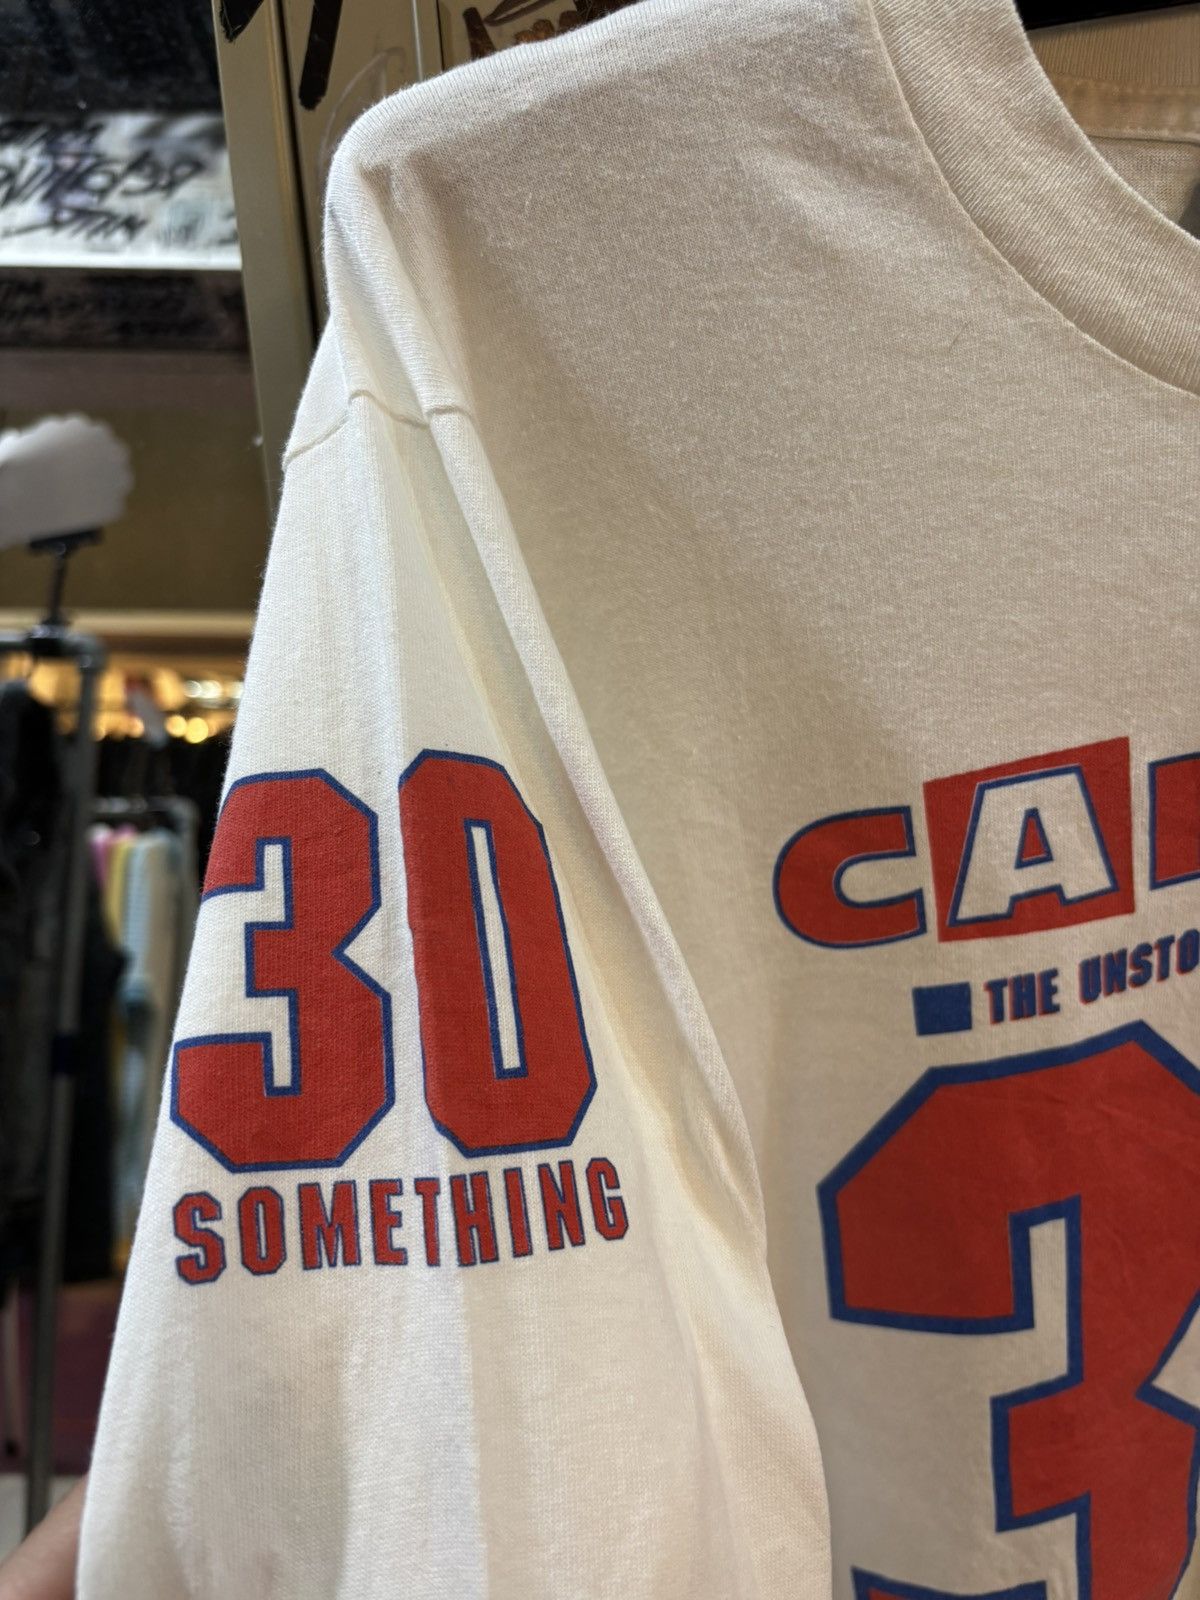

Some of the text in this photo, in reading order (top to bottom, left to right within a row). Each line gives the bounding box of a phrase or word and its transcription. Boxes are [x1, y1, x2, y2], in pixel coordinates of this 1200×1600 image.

[170, 749, 598, 1173] 30
[984, 928, 1200, 1025] THE UNSTO
[172, 1157, 629, 1285] SOMETHING
